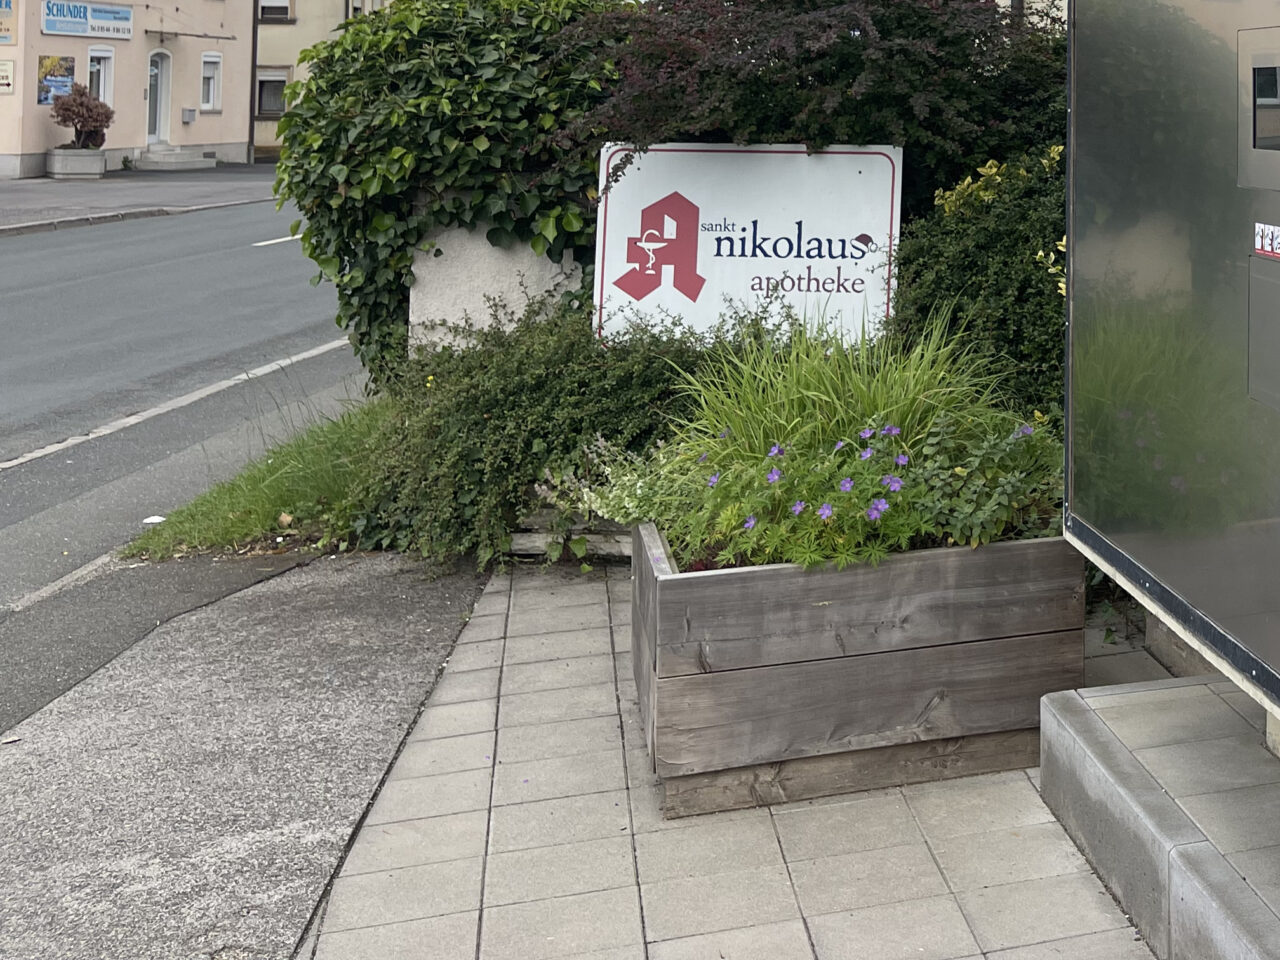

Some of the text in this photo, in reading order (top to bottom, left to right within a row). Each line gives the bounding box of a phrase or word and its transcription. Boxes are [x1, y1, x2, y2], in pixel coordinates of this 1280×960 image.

[46, 0, 88, 21] SCHUNDER
[700, 217, 736, 232] sankt
[713, 219, 868, 260] nikolaus
[750, 265, 865, 299] apotheke
